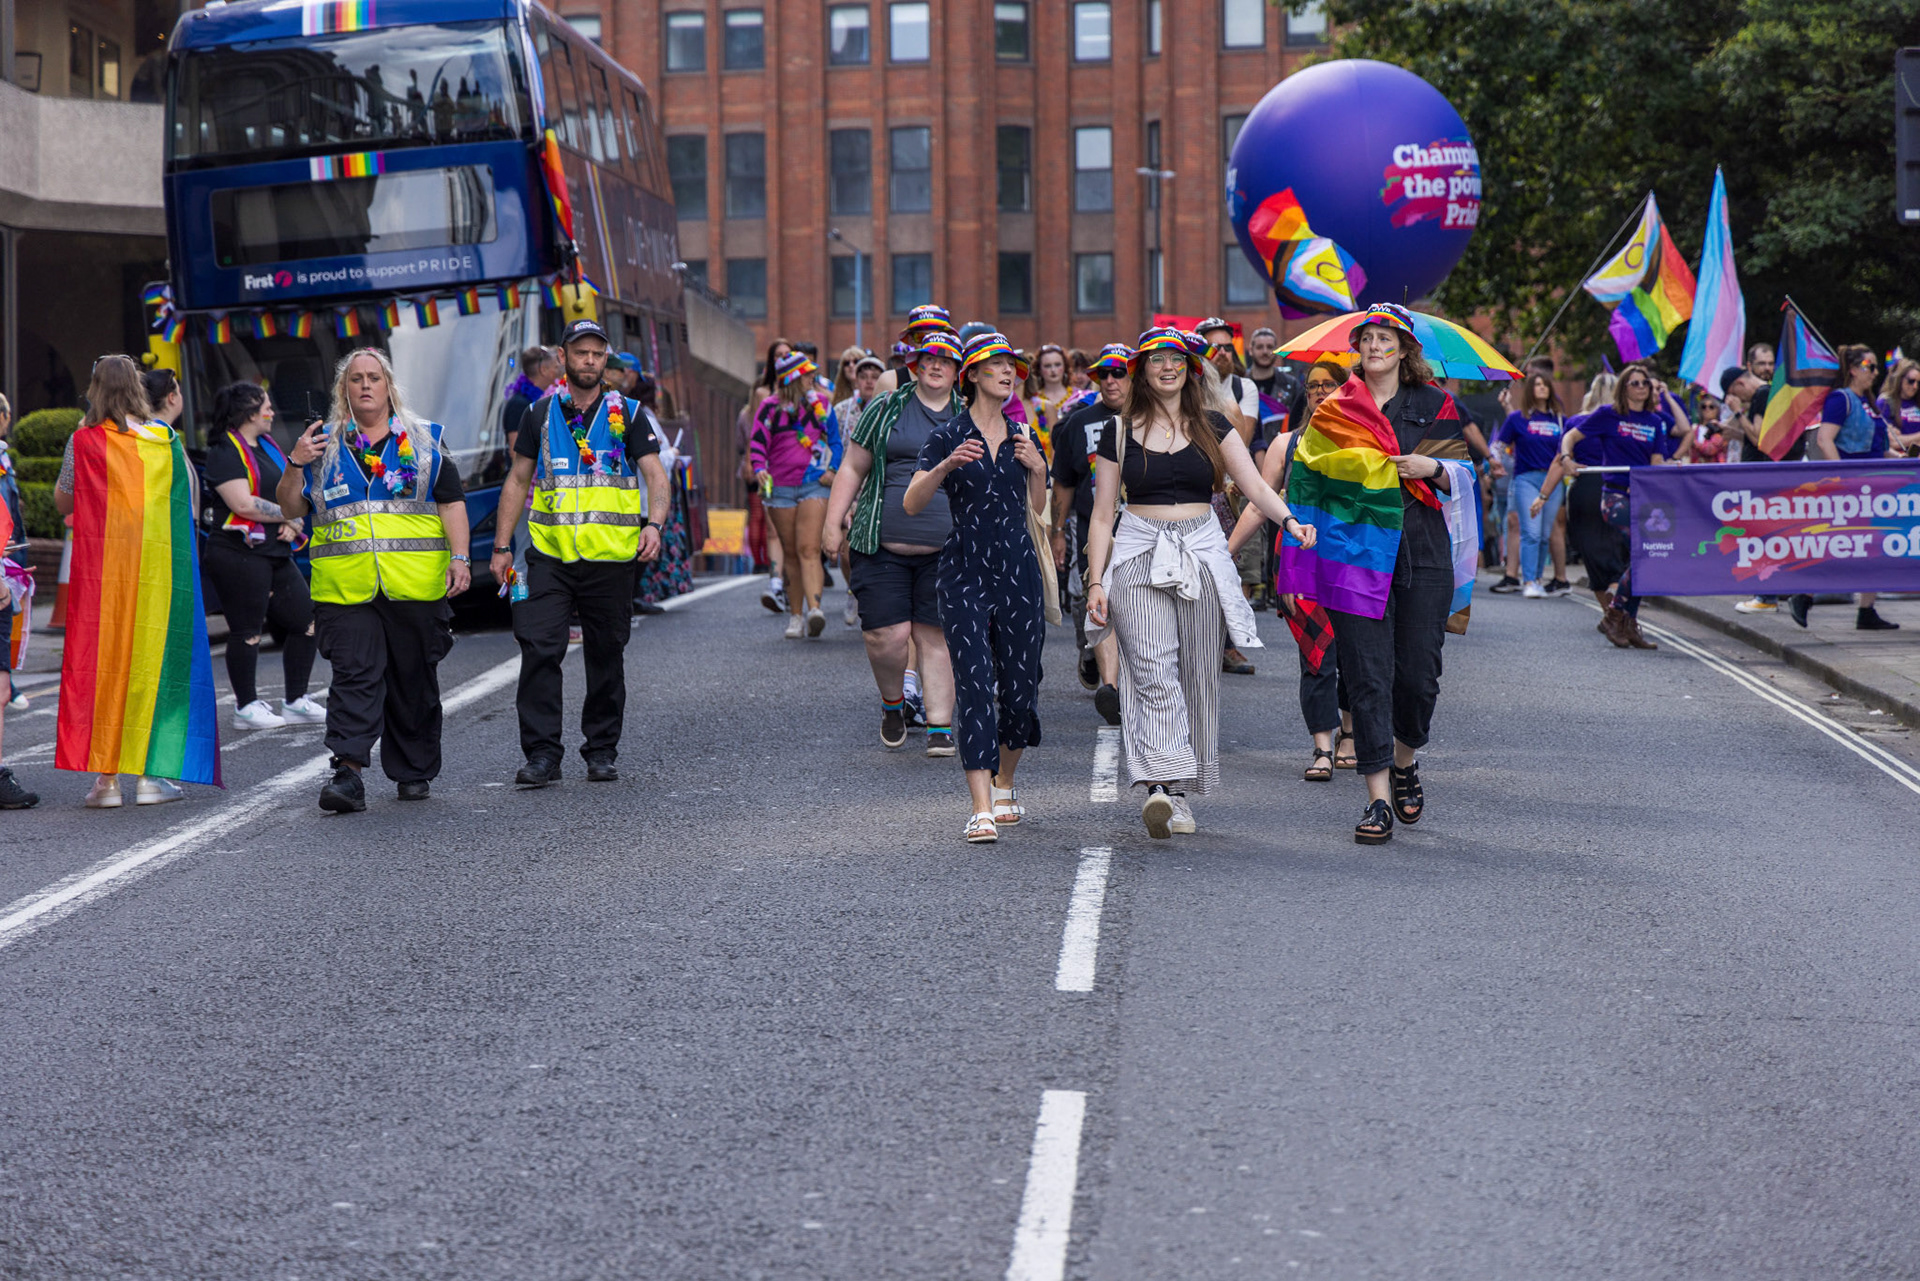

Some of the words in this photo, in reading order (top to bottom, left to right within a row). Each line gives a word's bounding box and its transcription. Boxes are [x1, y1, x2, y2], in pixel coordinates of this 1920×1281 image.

[1403, 173, 1447, 198] the
[244, 273, 274, 289] First
[297, 271, 308, 284] is
[310, 266, 347, 285] proud
[349, 268, 364, 280] to
[365, 263, 417, 279] support
[418, 255, 473, 272] PRIDE
[1711, 485, 1920, 525] Champion
[323, 520, 357, 542] 283
[1643, 542, 1674, 551] NatWest
[1648, 550, 1669, 558] Group
[1736, 533, 1873, 568] power
[1882, 525, 1920, 557] of
